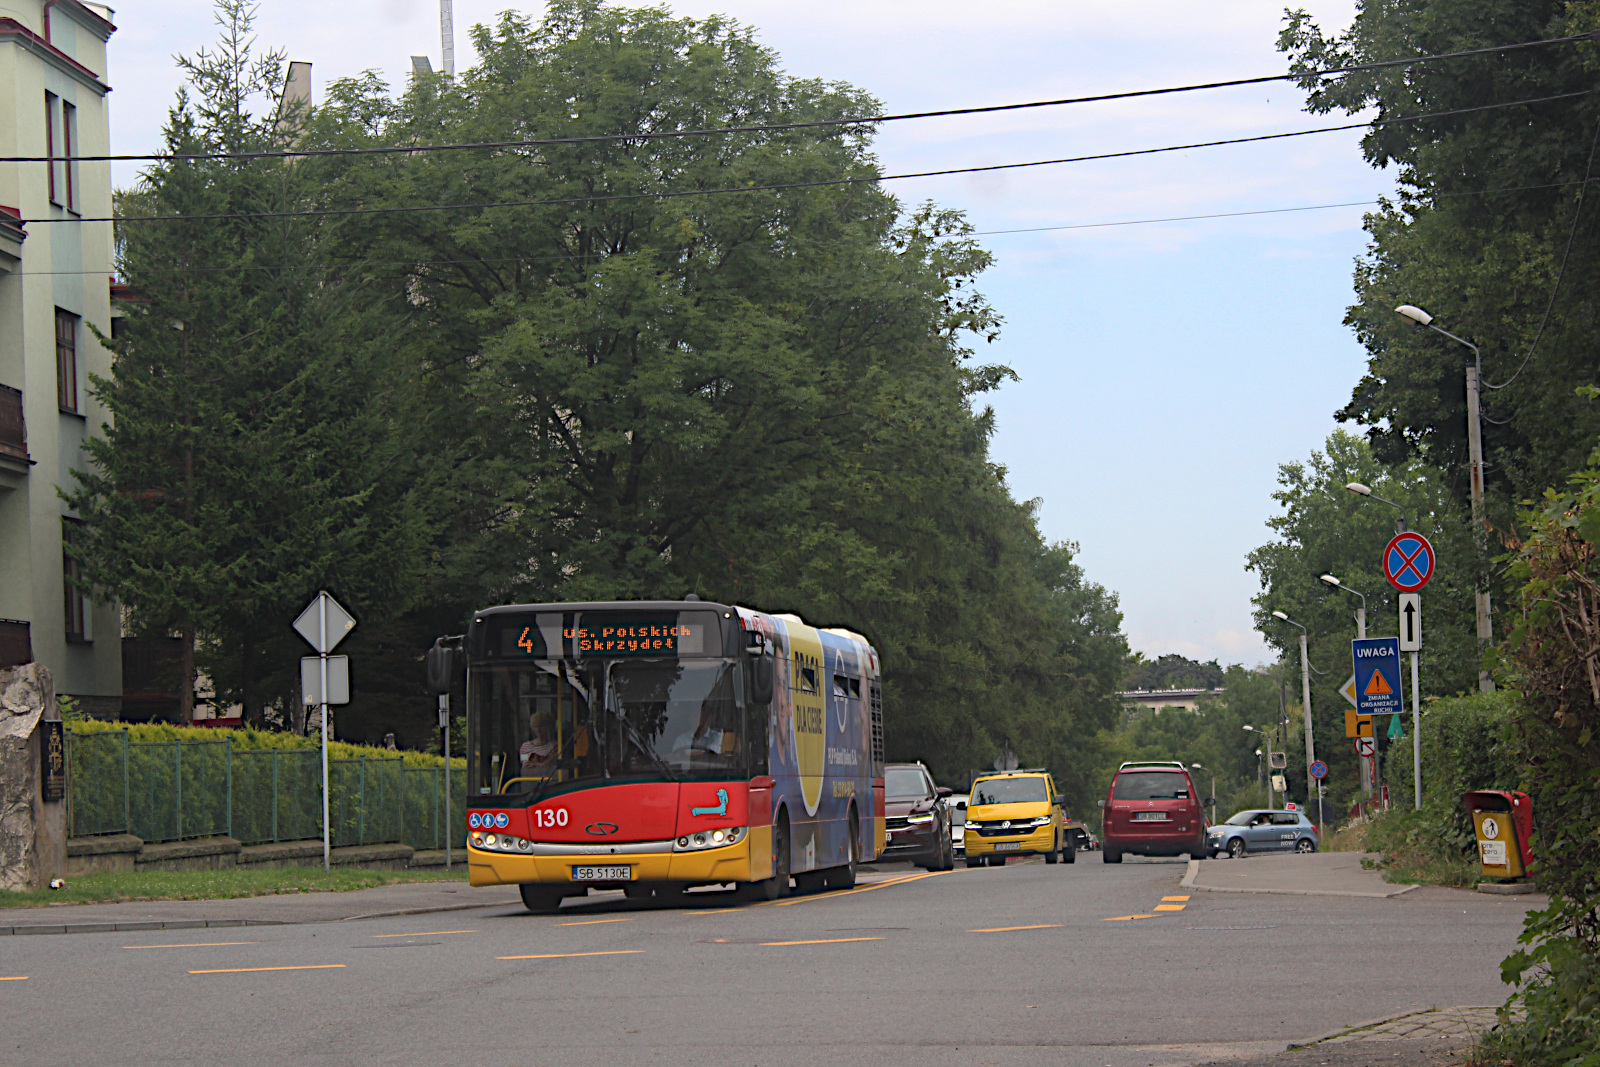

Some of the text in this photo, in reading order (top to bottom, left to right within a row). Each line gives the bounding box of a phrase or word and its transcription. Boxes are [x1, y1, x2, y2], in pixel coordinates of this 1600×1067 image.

[603, 625, 691, 638] Polskich
[518, 627, 533, 653] 4
[1357, 648, 1395, 657] UWAGA
[1360, 700, 1399, 708] ORGANIZACJI
[535, 808, 568, 827] 130
[579, 868, 629, 878] SB 5130E
